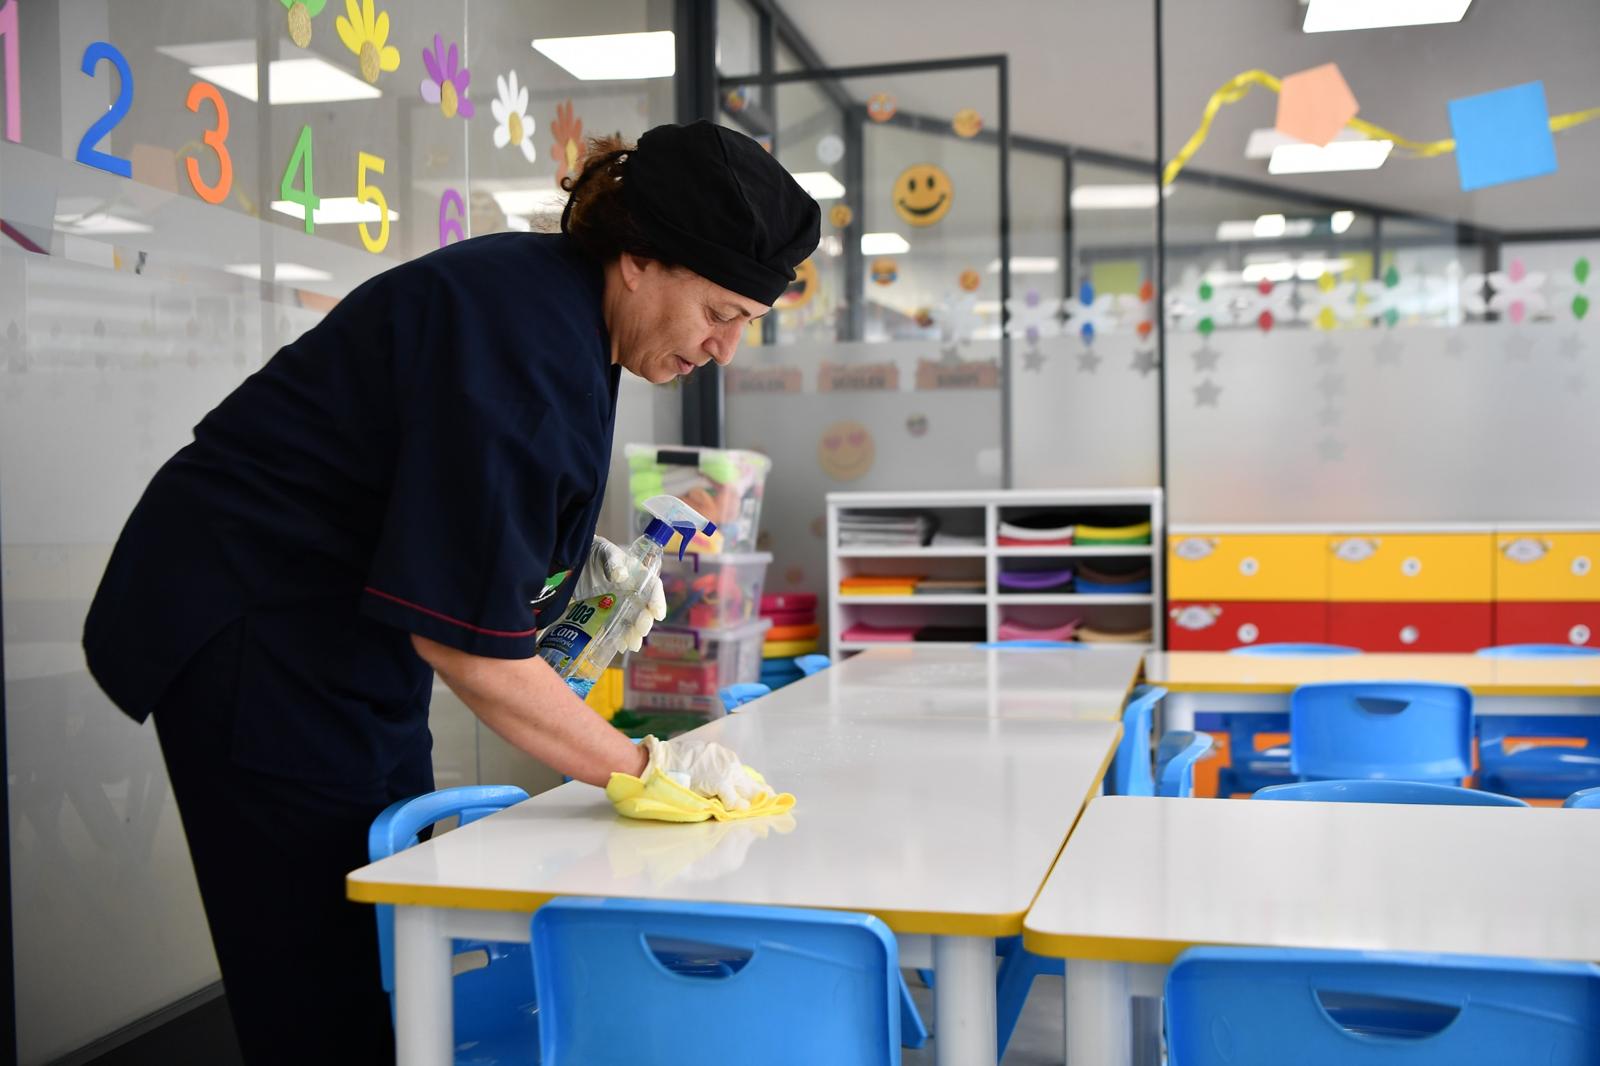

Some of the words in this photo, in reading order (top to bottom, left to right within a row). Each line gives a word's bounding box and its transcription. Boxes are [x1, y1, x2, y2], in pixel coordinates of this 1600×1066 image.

[0, 0, 21, 143] 1
[77, 41, 134, 178] 2
[186, 82, 233, 204] 3
[281, 125, 320, 233] 4
[358, 152, 389, 253] 5
[439, 188, 465, 249] 6
[550, 625, 579, 641] Cam
